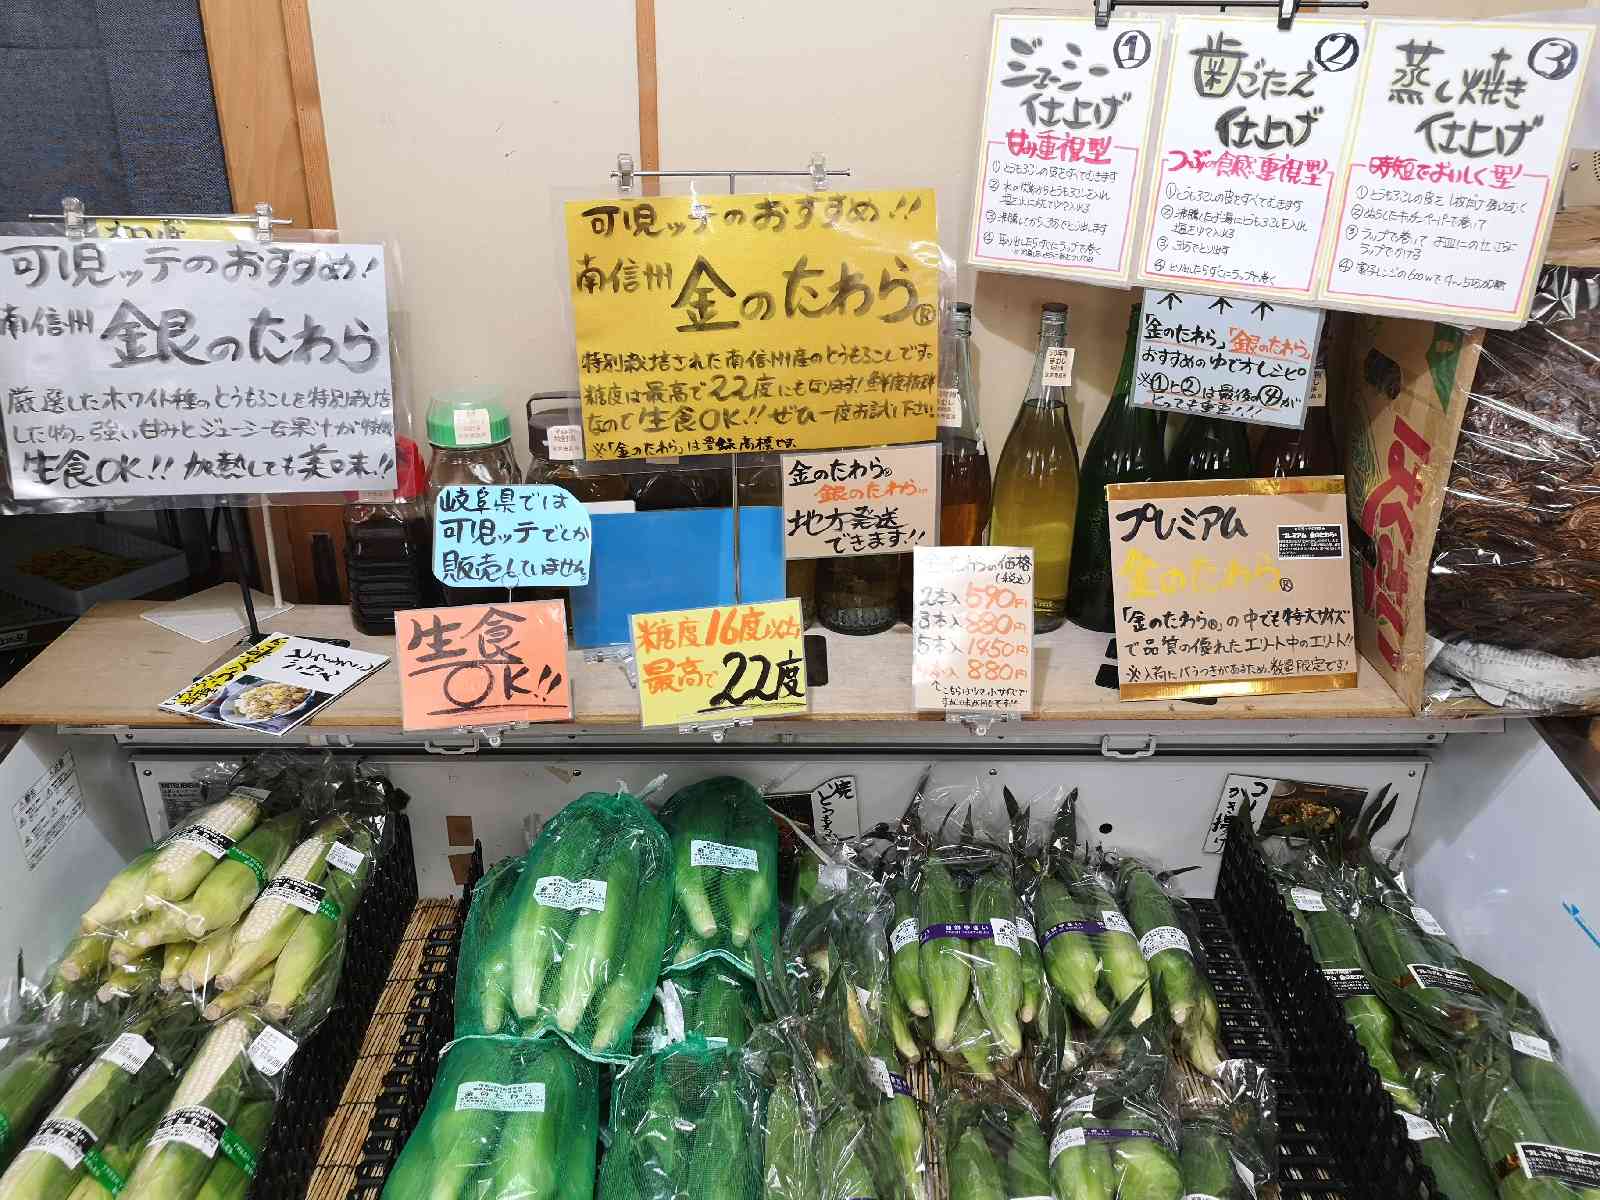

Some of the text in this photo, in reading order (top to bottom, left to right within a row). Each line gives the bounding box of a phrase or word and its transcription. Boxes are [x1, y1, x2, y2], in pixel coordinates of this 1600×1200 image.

[1188, 31, 1318, 100] 歯ごたえ
[1388, 38, 1528, 109] 蒸し焼き
[1020, 92, 1132, 129] 仕上げ
[1215, 106, 1325, 149] 仕上げ
[1415, 111, 1544, 158] 仕上げ
[576, 254, 672, 294] 南信州
[0, 298, 385, 373] 南信州 銀のたわら
[440, 487, 569, 515] 岐阜県では
[787, 505, 909, 536] 地方発送
[1116, 503, 1248, 541] プレミアム
[408, 607, 527, 664] 生食
